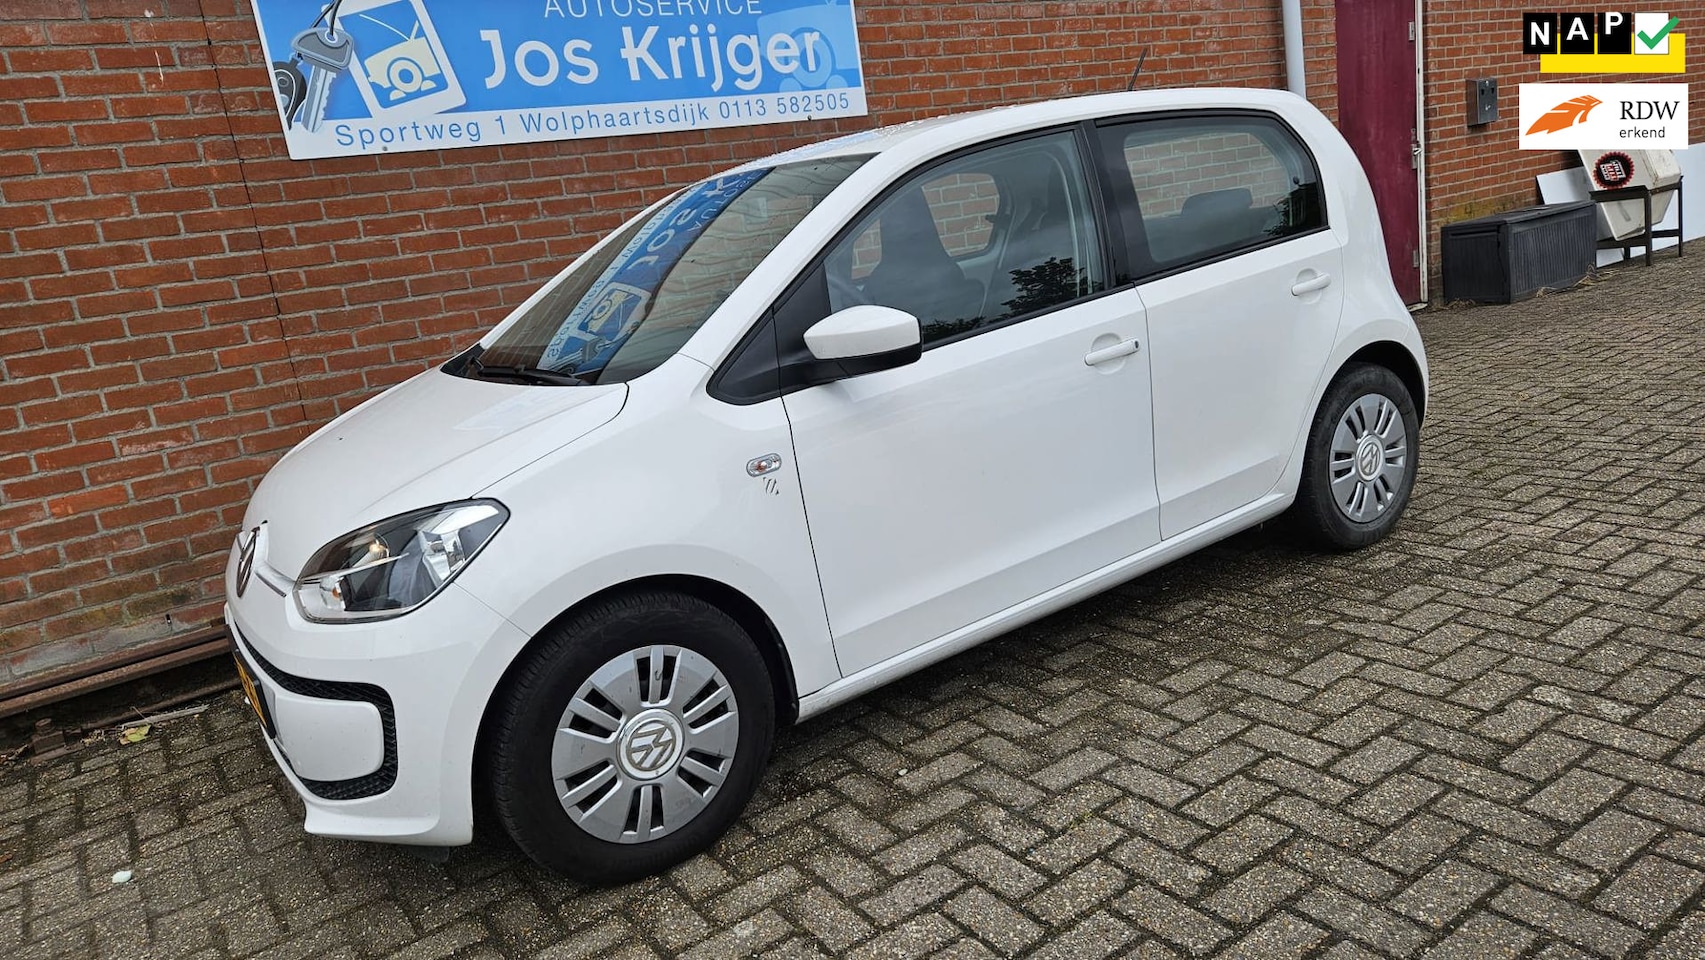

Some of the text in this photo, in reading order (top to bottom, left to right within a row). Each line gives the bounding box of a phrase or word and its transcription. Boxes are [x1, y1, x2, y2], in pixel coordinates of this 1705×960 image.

[544, 0, 763, 18] AUTOSERVICE
[480, 23, 820, 92] Jos Krijger
[335, 92, 850, 149] Sportweg 1 Wolphaartsdijk 0113 582505
